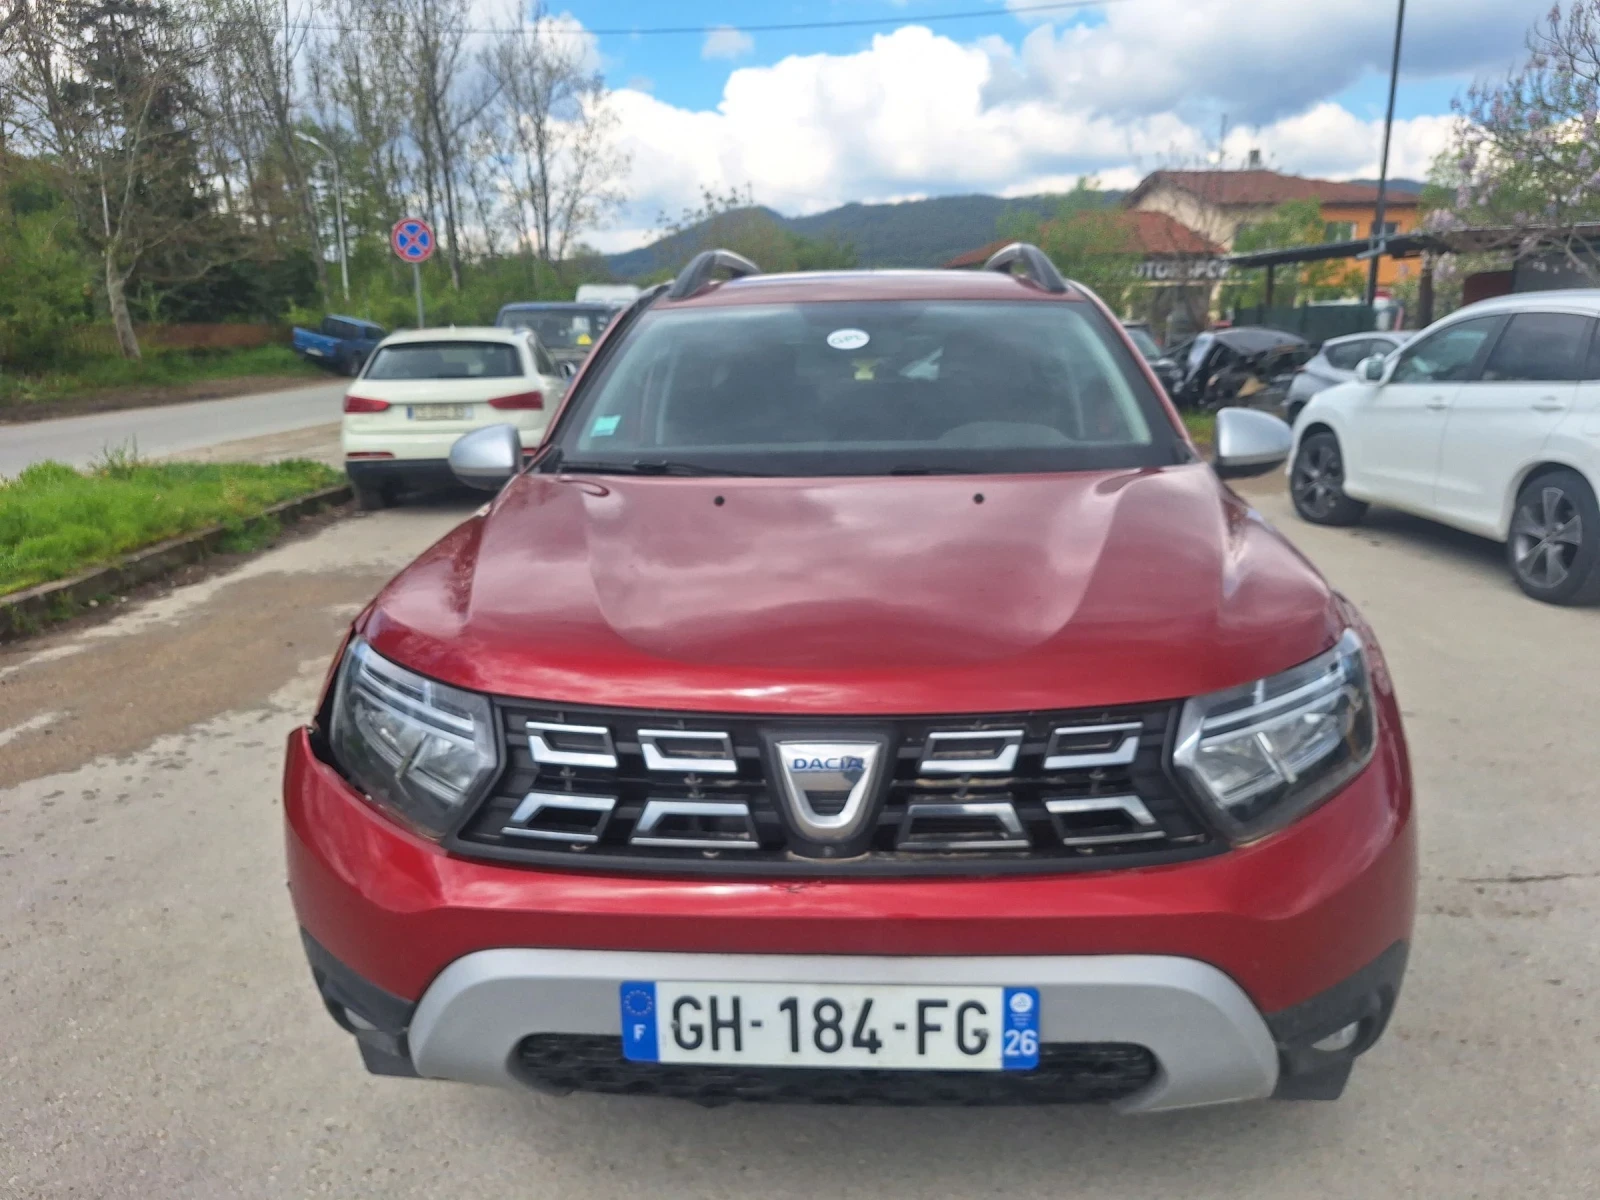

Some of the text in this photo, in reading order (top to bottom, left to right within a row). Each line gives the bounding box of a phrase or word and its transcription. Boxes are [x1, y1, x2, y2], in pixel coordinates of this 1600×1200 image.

[794, 758, 863, 769] DACIA
[633, 1024, 646, 1042] F
[671, 995, 989, 1056] GH-184-FG
[1004, 1029, 1038, 1056] 26
